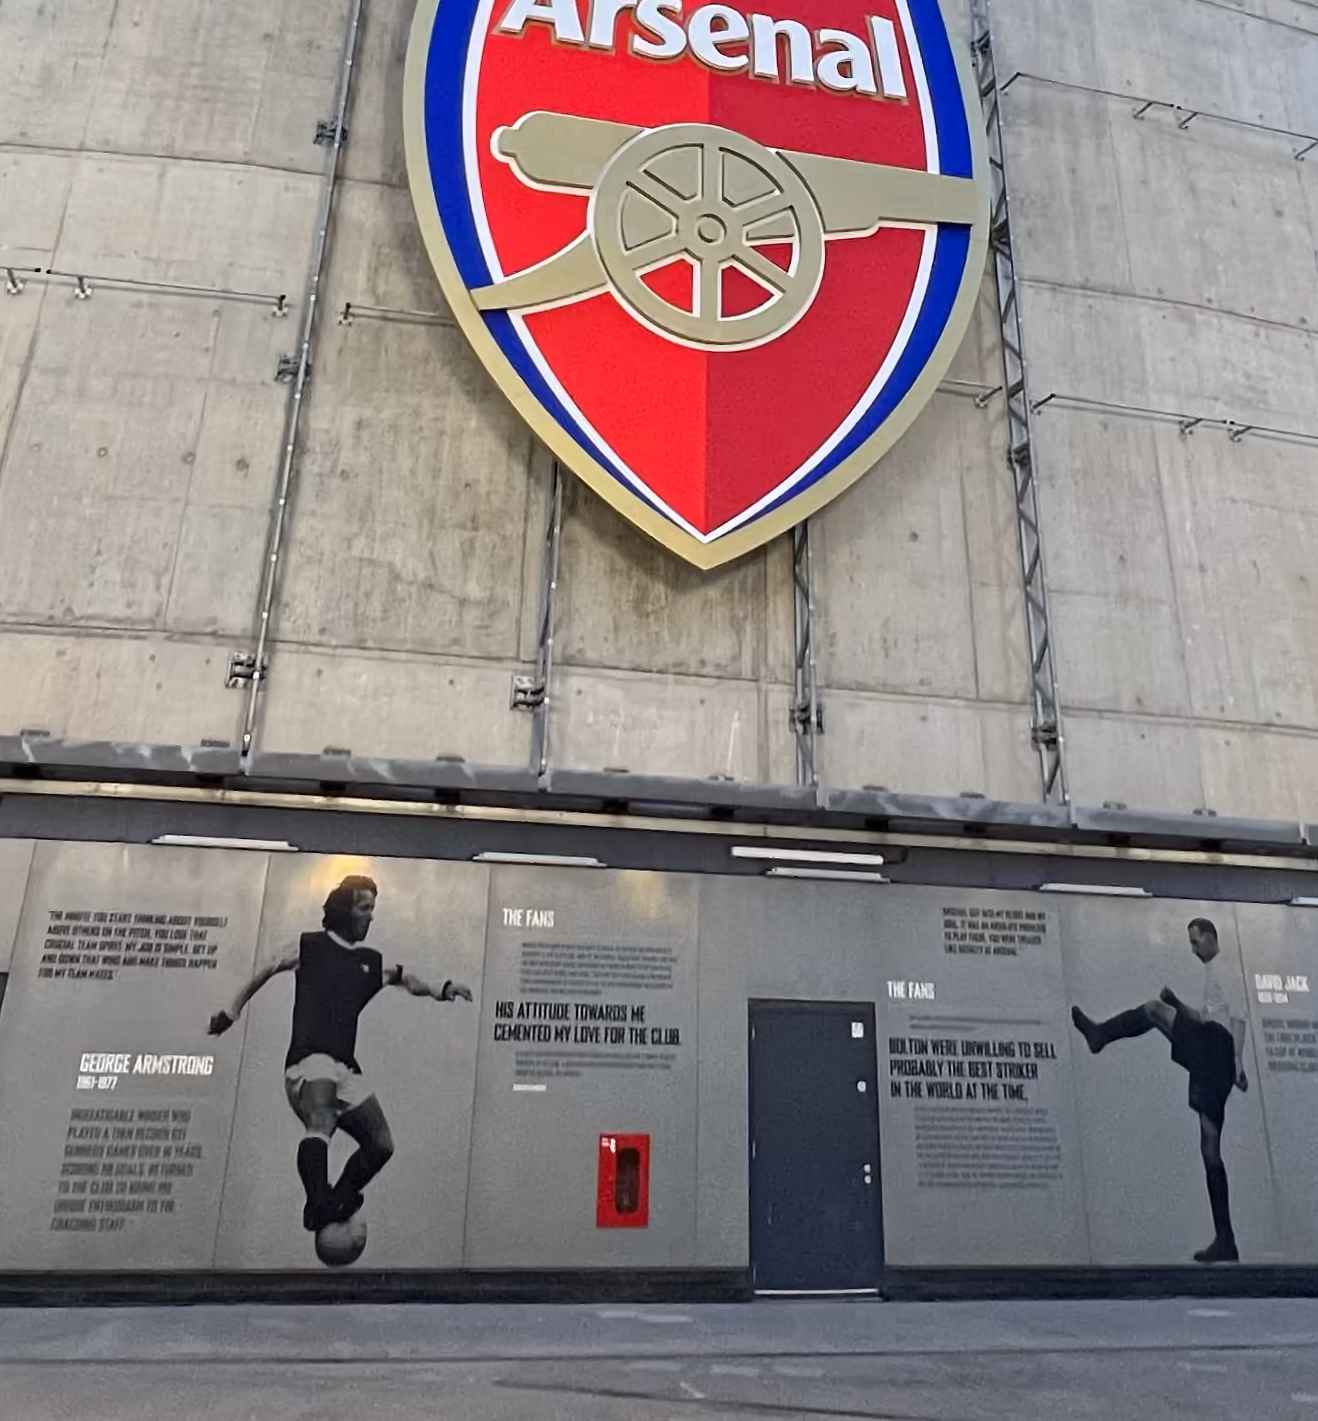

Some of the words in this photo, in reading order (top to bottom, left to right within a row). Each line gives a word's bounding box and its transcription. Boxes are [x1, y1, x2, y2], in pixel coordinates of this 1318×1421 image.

[503, 908, 523, 926] THE
[526, 909, 554, 927] FANS
[887, 981, 905, 999] THE
[908, 982, 935, 999] FANS
[1255, 973, 1284, 990] DAVID
[1285, 975, 1310, 992] JACK
[496, 1000, 514, 1019] HIS
[517, 1002, 570, 1021] ATTITUDE
[574, 1003, 627, 1022] TOWARDS
[631, 1005, 646, 1023] ME
[494, 1023, 551, 1042] CEMENTED
[554, 1025, 572, 1042] MY
[574, 1026, 600, 1043] LOVE
[604, 1027, 624, 1044] FOR
[627, 1027, 647, 1045] THE
[651, 1028, 682, 1045] CLUB.
[889, 1037, 928, 1055] BOLTON
[931, 1038, 958, 1056] WERE
[961, 1040, 1015, 1058] UNWILLING
[1018, 1042, 1031, 1058] TO
[1034, 1042, 1057, 1059] SELL
[80, 1053, 131, 1073] GEORGE
[133, 1055, 214, 1075] ARMSTRONG
[890, 1059, 944, 1077] PROBABLY
[947, 1061, 965, 1077] THE
[968, 1061, 993, 1078] BEST
[996, 1062, 1038, 1079] STRIKER
[890, 1081, 901, 1098] IN
[904, 1081, 922, 1098] THE
[925, 1082, 963, 1100] WORLD
[966, 1083, 978, 1100] AT
[980, 1083, 999, 1100] THE
